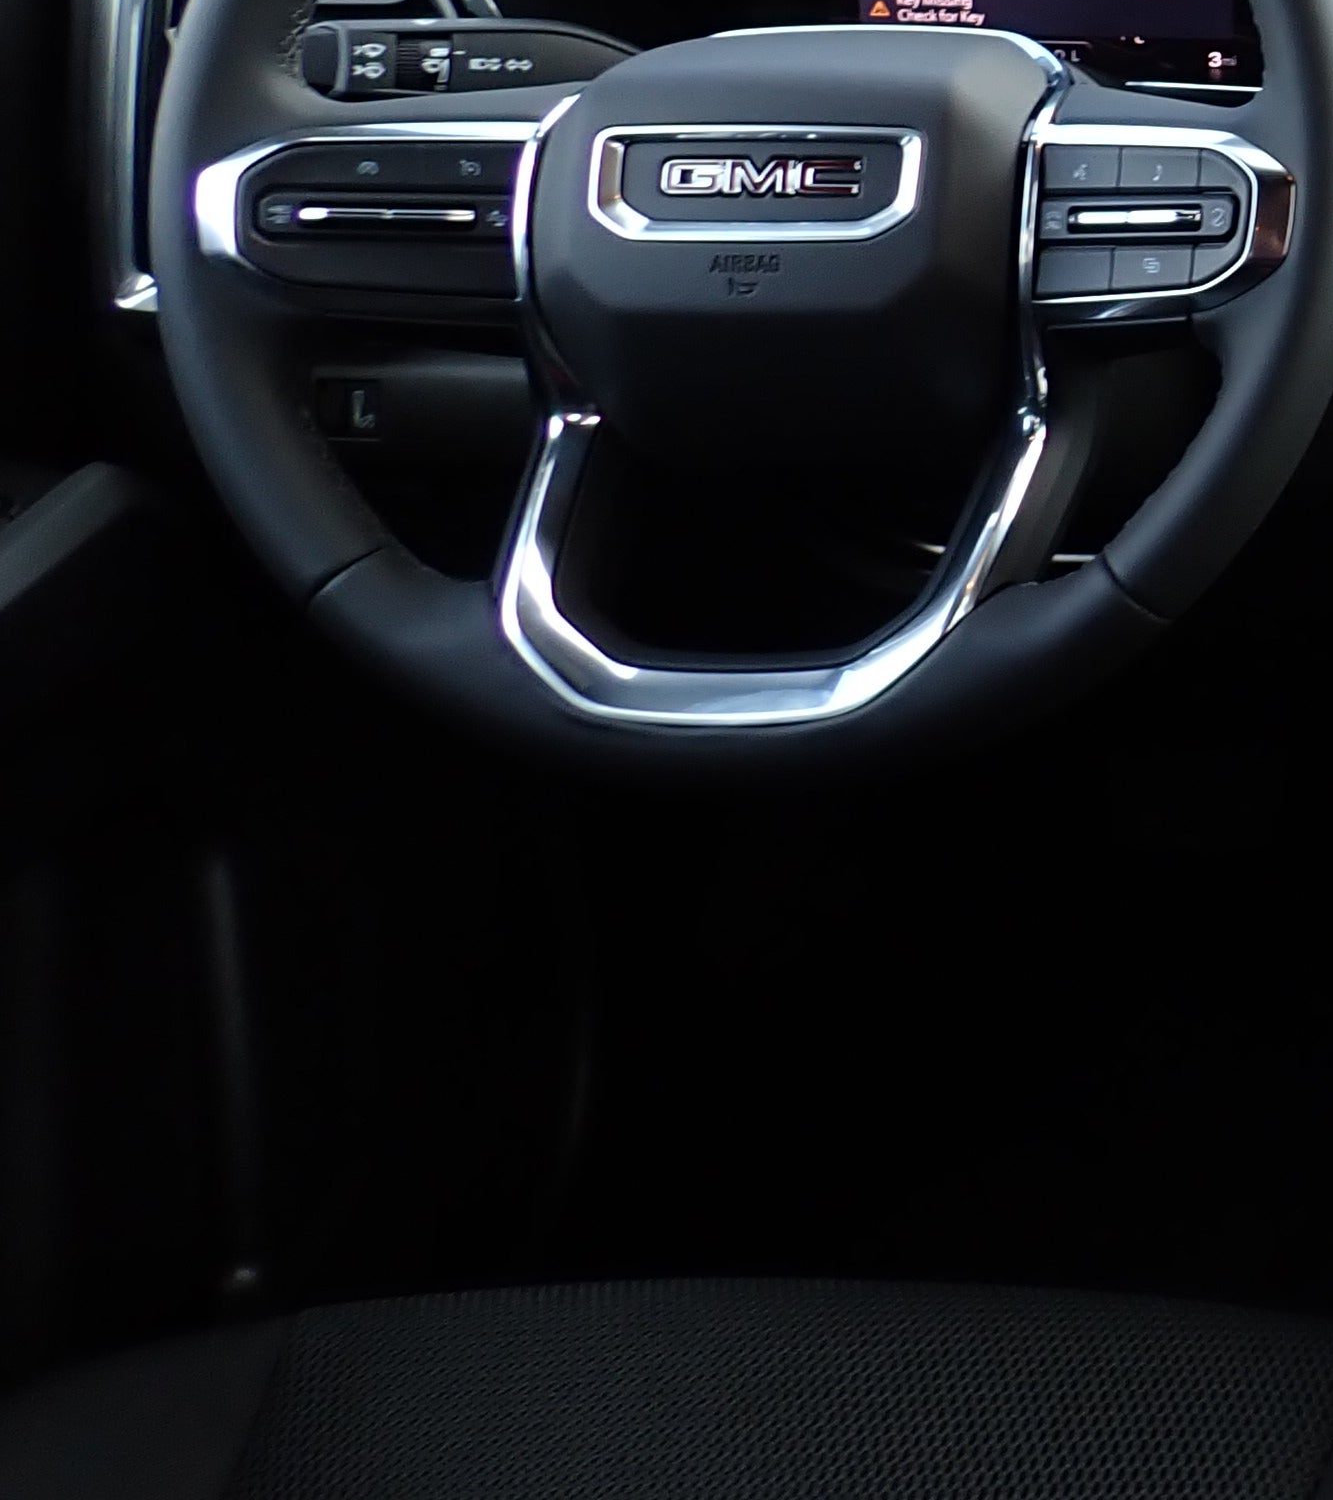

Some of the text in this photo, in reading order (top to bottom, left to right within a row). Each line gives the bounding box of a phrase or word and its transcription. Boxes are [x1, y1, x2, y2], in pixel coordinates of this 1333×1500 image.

[896, 8, 986, 26] Check for Key
[1207, 51, 1222, 68] 3
[660, 155, 864, 197] GMC
[708, 254, 780, 273] AIRBAG
